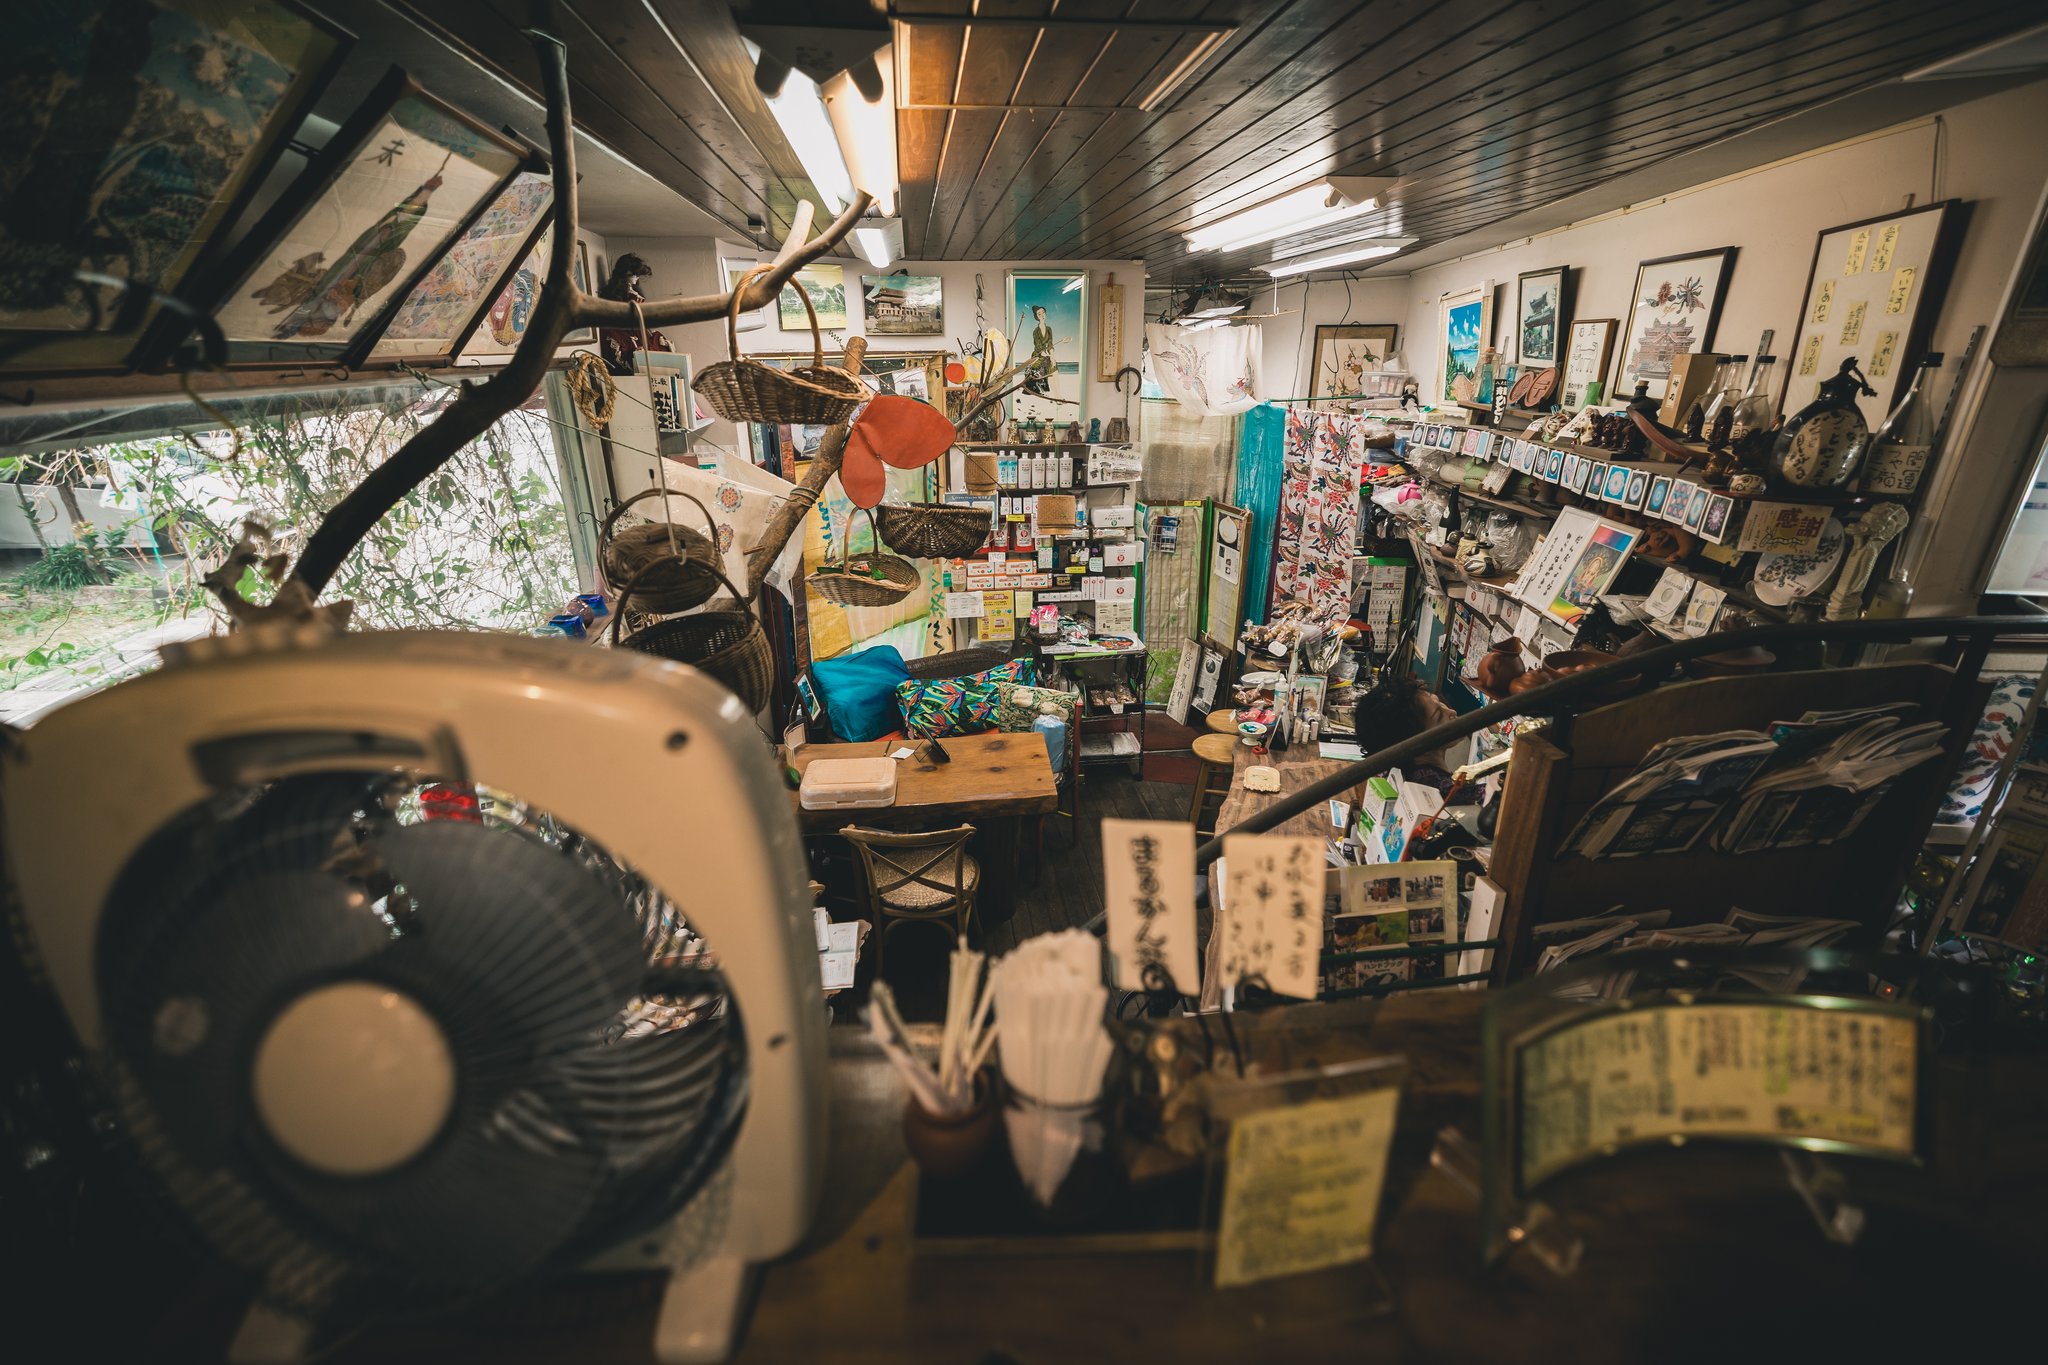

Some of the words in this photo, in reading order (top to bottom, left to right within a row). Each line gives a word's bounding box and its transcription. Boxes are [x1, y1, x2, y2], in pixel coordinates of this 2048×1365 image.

[1817, 283, 1830, 322] しあわせ
[1891, 268, 1914, 313] ついてる
[1874, 333, 1893, 376] うれしい
[1776, 507, 1825, 538] 感謝
[1363, 960, 1404, 971] ハンドブック
